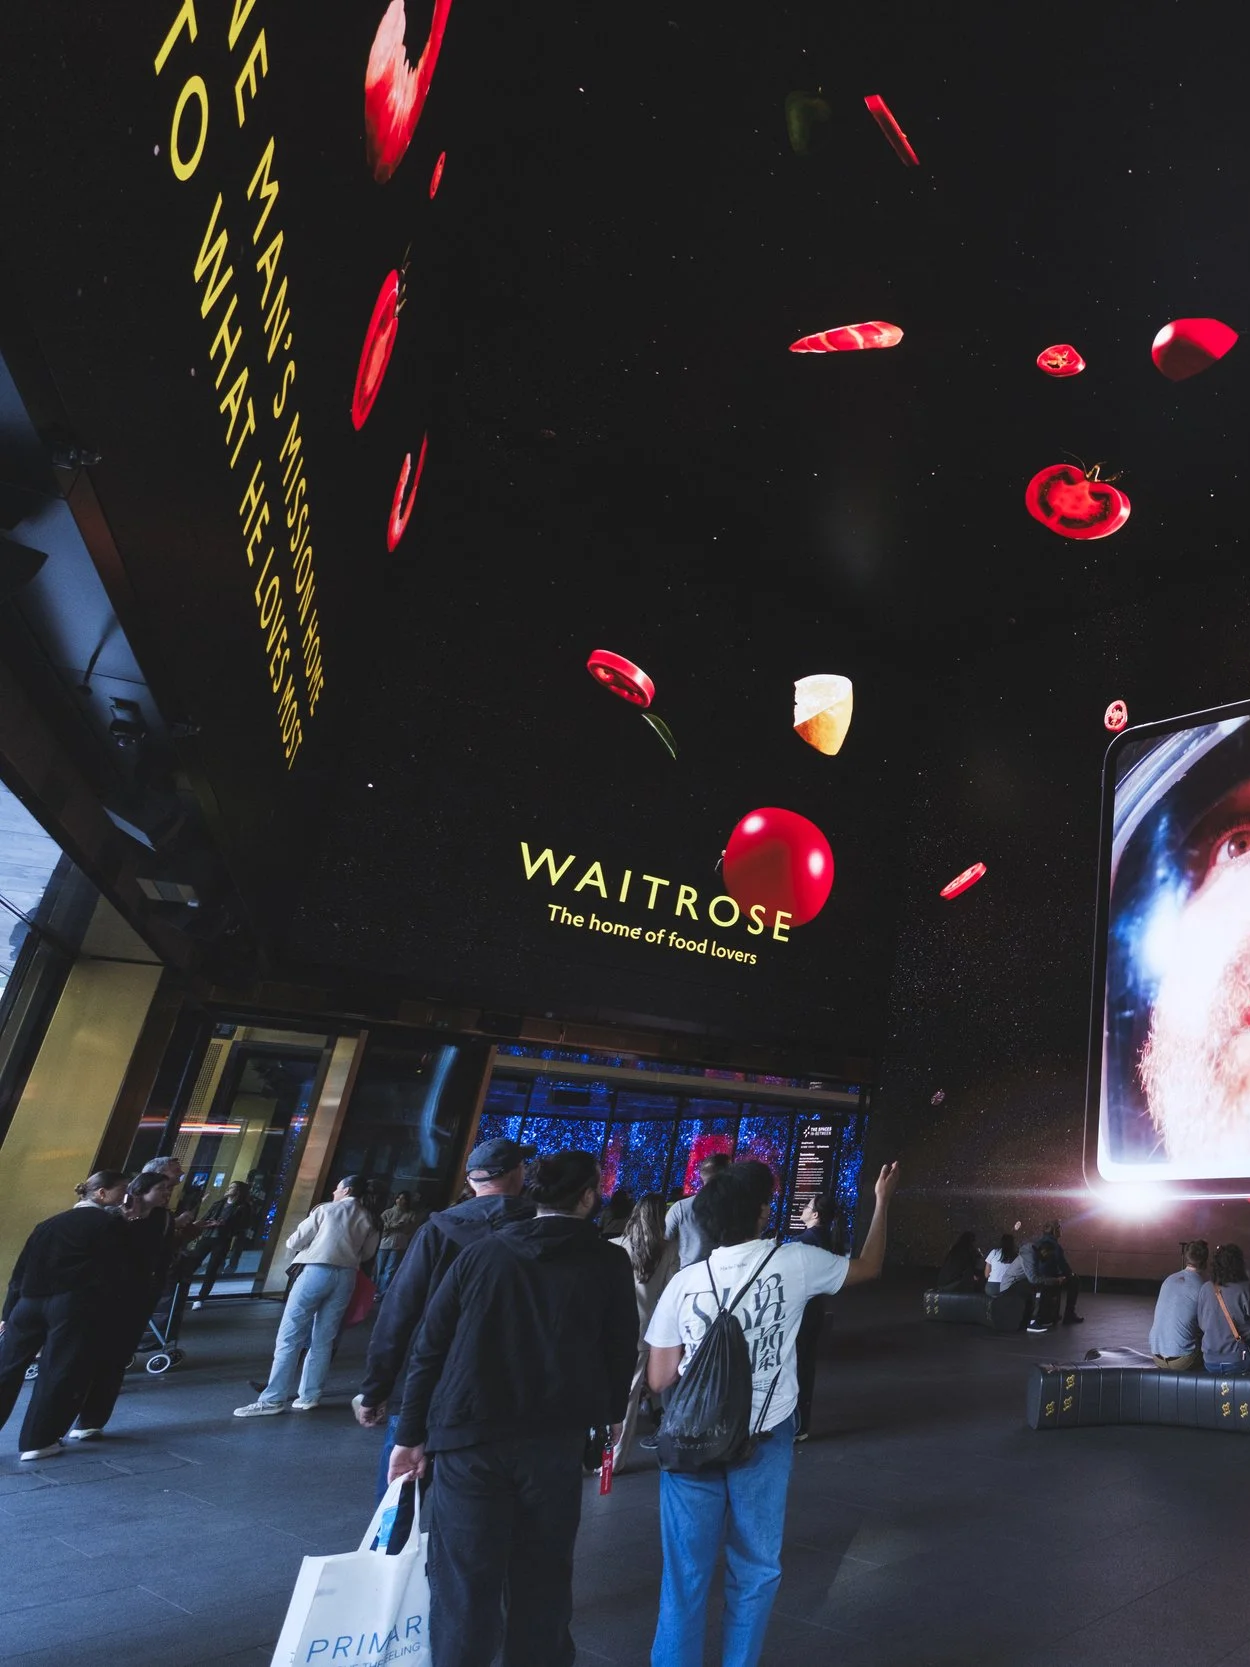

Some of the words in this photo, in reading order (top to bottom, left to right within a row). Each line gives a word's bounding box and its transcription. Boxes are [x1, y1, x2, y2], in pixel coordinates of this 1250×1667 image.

[154, 0, 208, 181] TO
[194, 192, 255, 468] WHAT
[239, 460, 269, 567] HE
[255, 547, 290, 693] LOVES
[278, 676, 303, 769] MOST
[247, 136, 295, 418] MAN'S
[279, 413, 315, 624] MISSION
[302, 610, 323, 717] HOME
[520, 842, 793, 943] WAITROSE
[547, 903, 585, 928] The
[589, 912, 642, 940] home
[645, 928, 667, 945] of
[668, 931, 707, 955] food
[711, 941, 758, 965] lovers
[306, 1614, 430, 1663] PRIMAR
